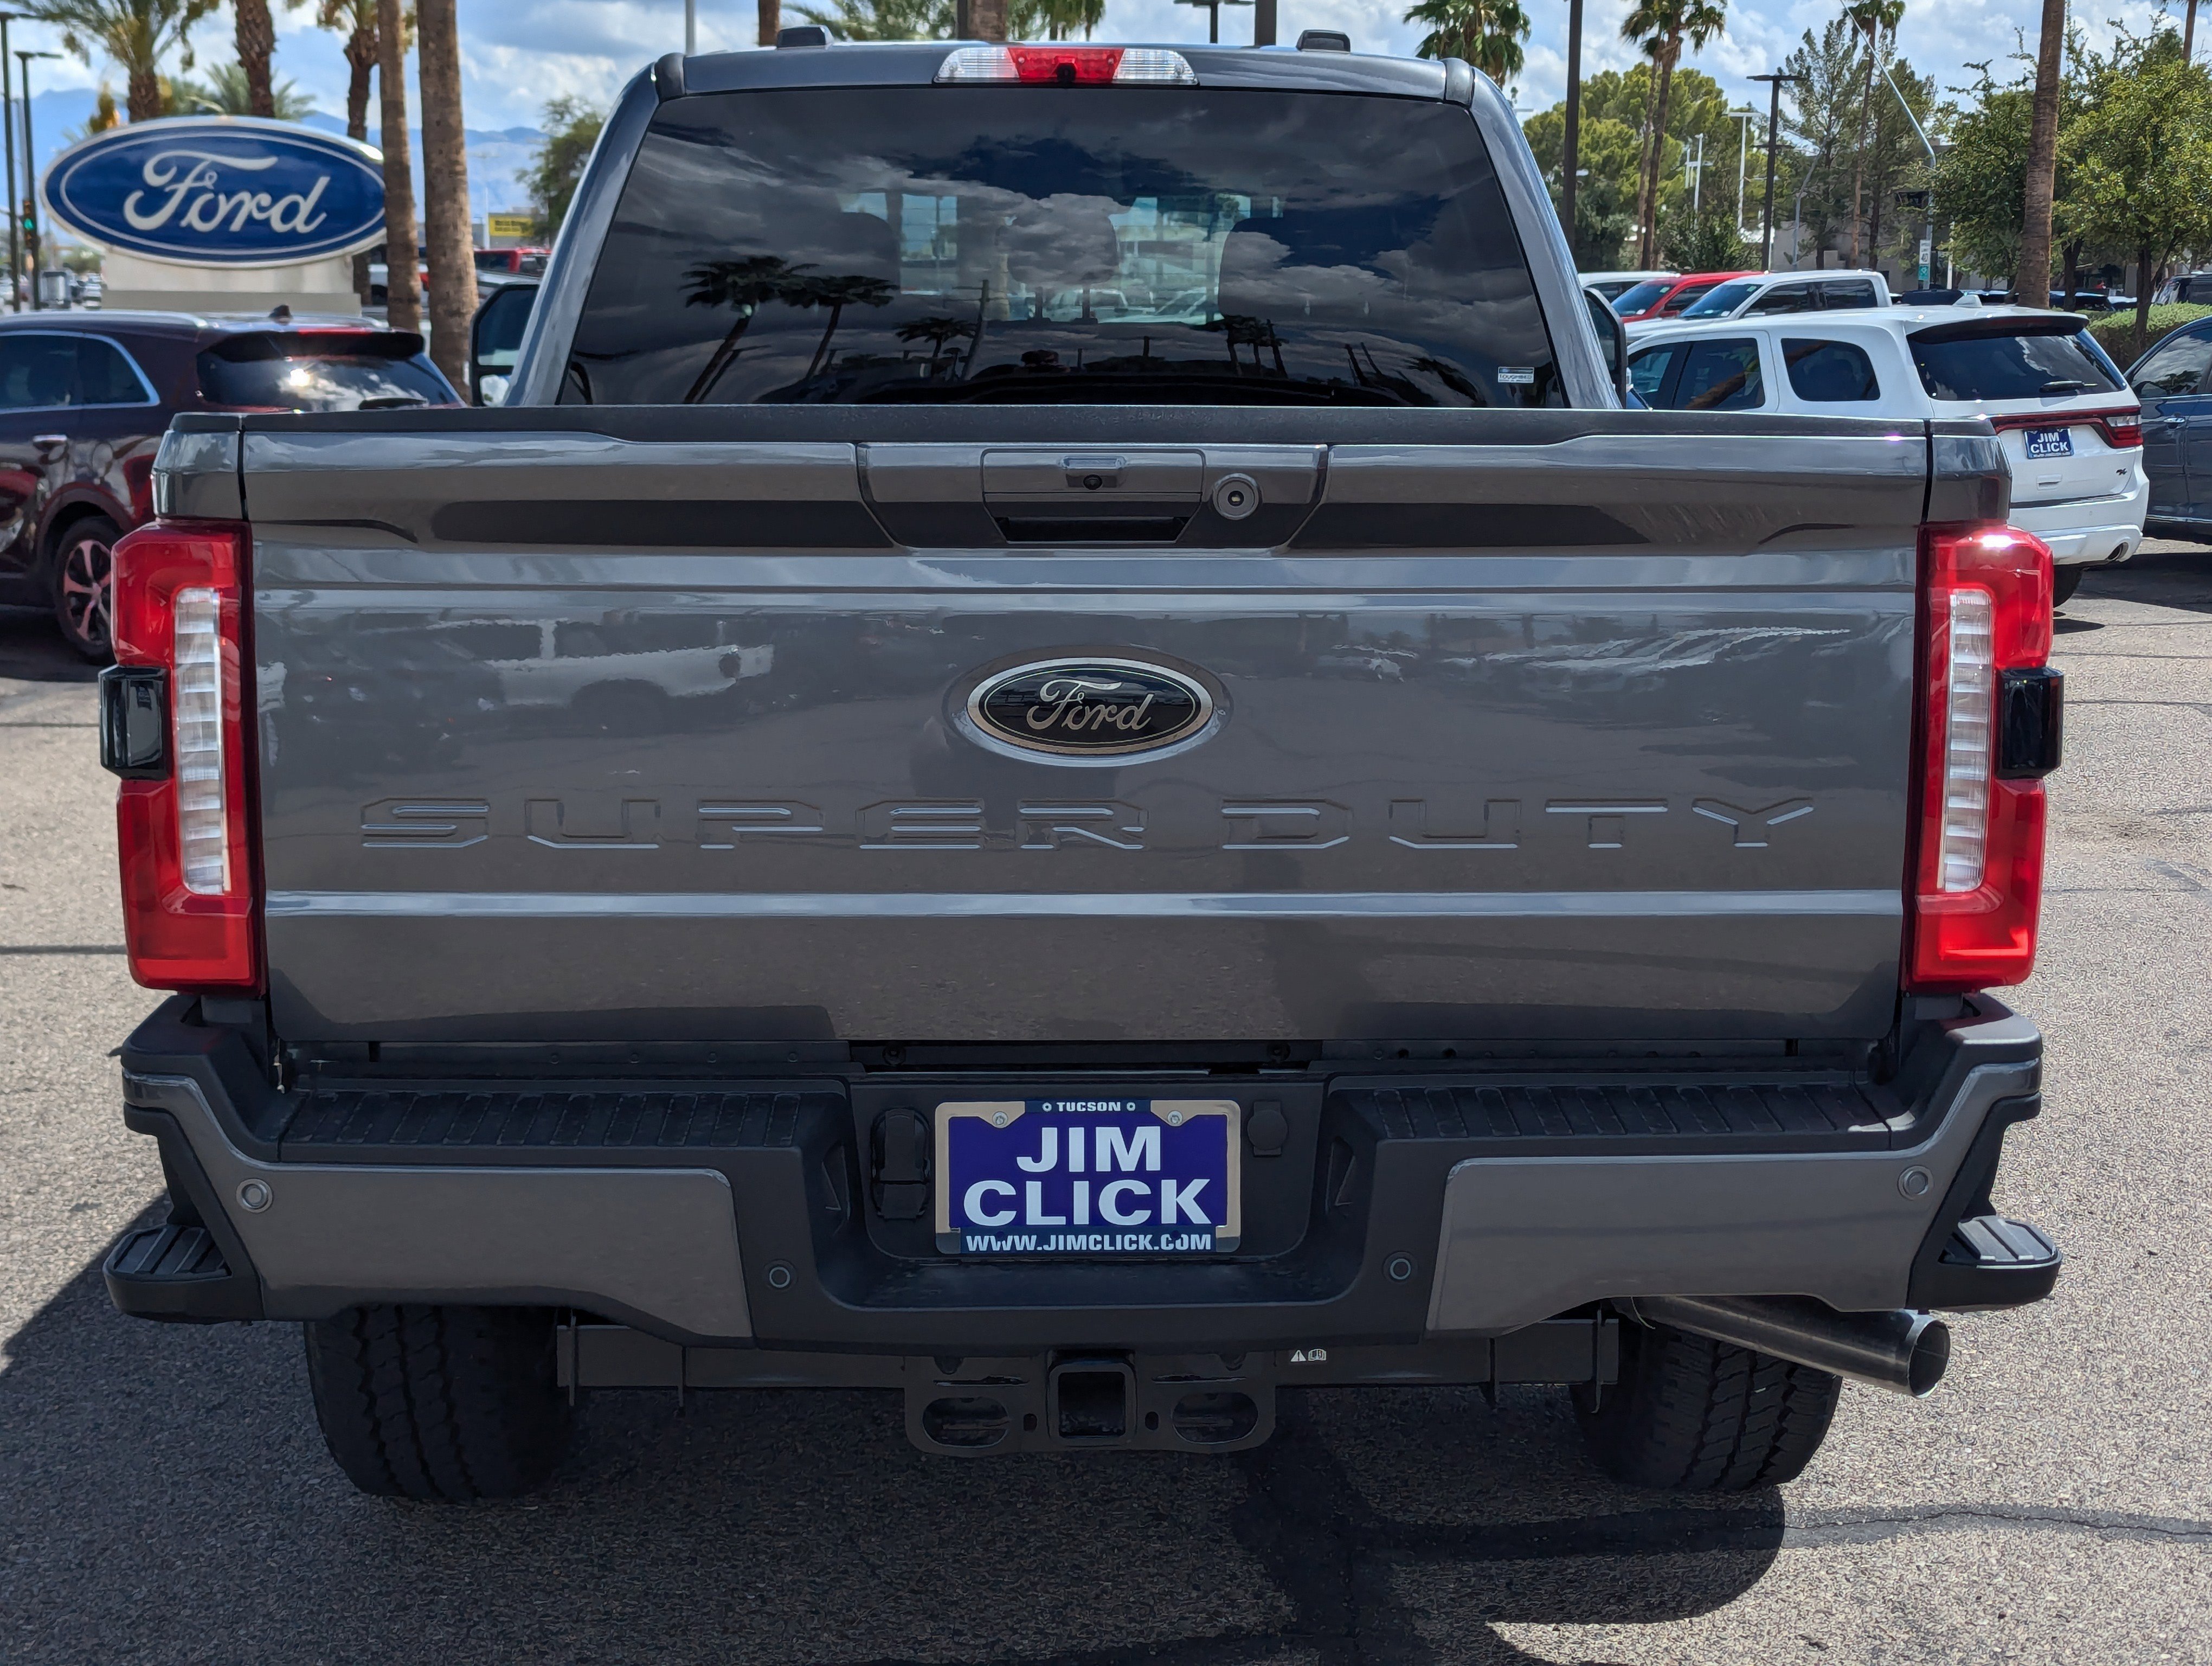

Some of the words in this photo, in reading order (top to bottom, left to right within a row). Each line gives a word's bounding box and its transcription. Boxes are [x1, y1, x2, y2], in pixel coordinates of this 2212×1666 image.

[123, 149, 331, 234] Ford
[2030, 442, 2069, 453] CLICK
[2037, 432, 2060, 443] JIM
[1026, 678, 1154, 731] Ford
[361, 797, 1149, 849] SUPER
[1221, 797, 1815, 849] DUTY
[1056, 1101, 1121, 1112] TUCSON
[1016, 1125, 1161, 1172] JIM
[963, 1178, 1212, 1227] CLICK
[966, 1234, 1212, 1252] WWW.JIMCLICK.COM
